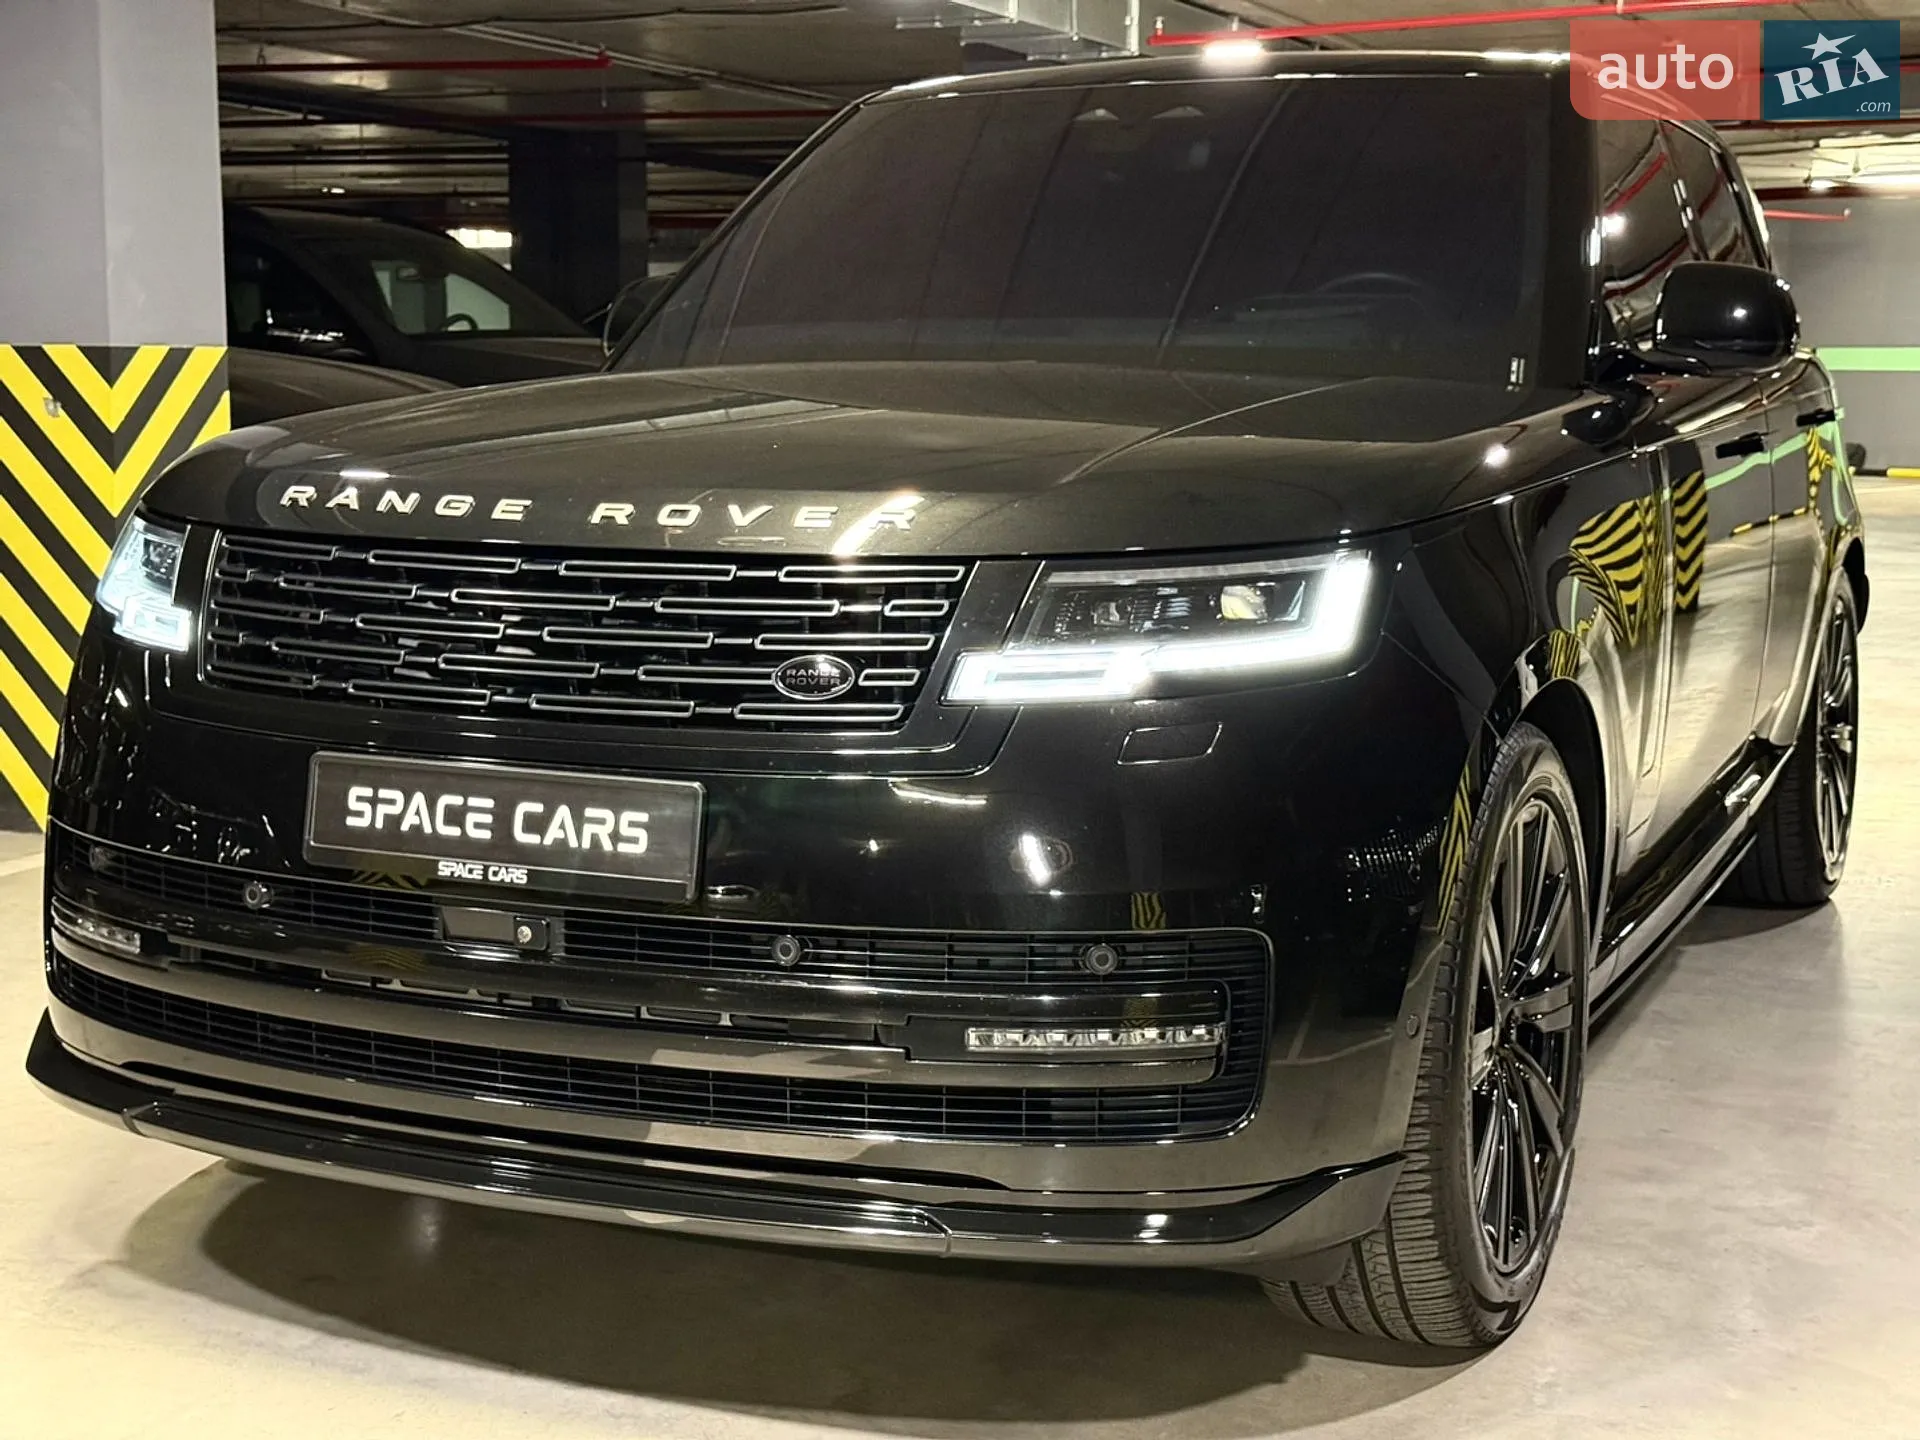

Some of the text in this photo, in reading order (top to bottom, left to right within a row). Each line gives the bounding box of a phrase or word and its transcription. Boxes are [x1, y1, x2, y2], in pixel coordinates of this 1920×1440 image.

[280, 485, 918, 530] RANGE ROVER
[786, 678, 840, 686] ROVER
[345, 786, 650, 854] SPACE CARS
[438, 861, 528, 884] SPACE CARS
